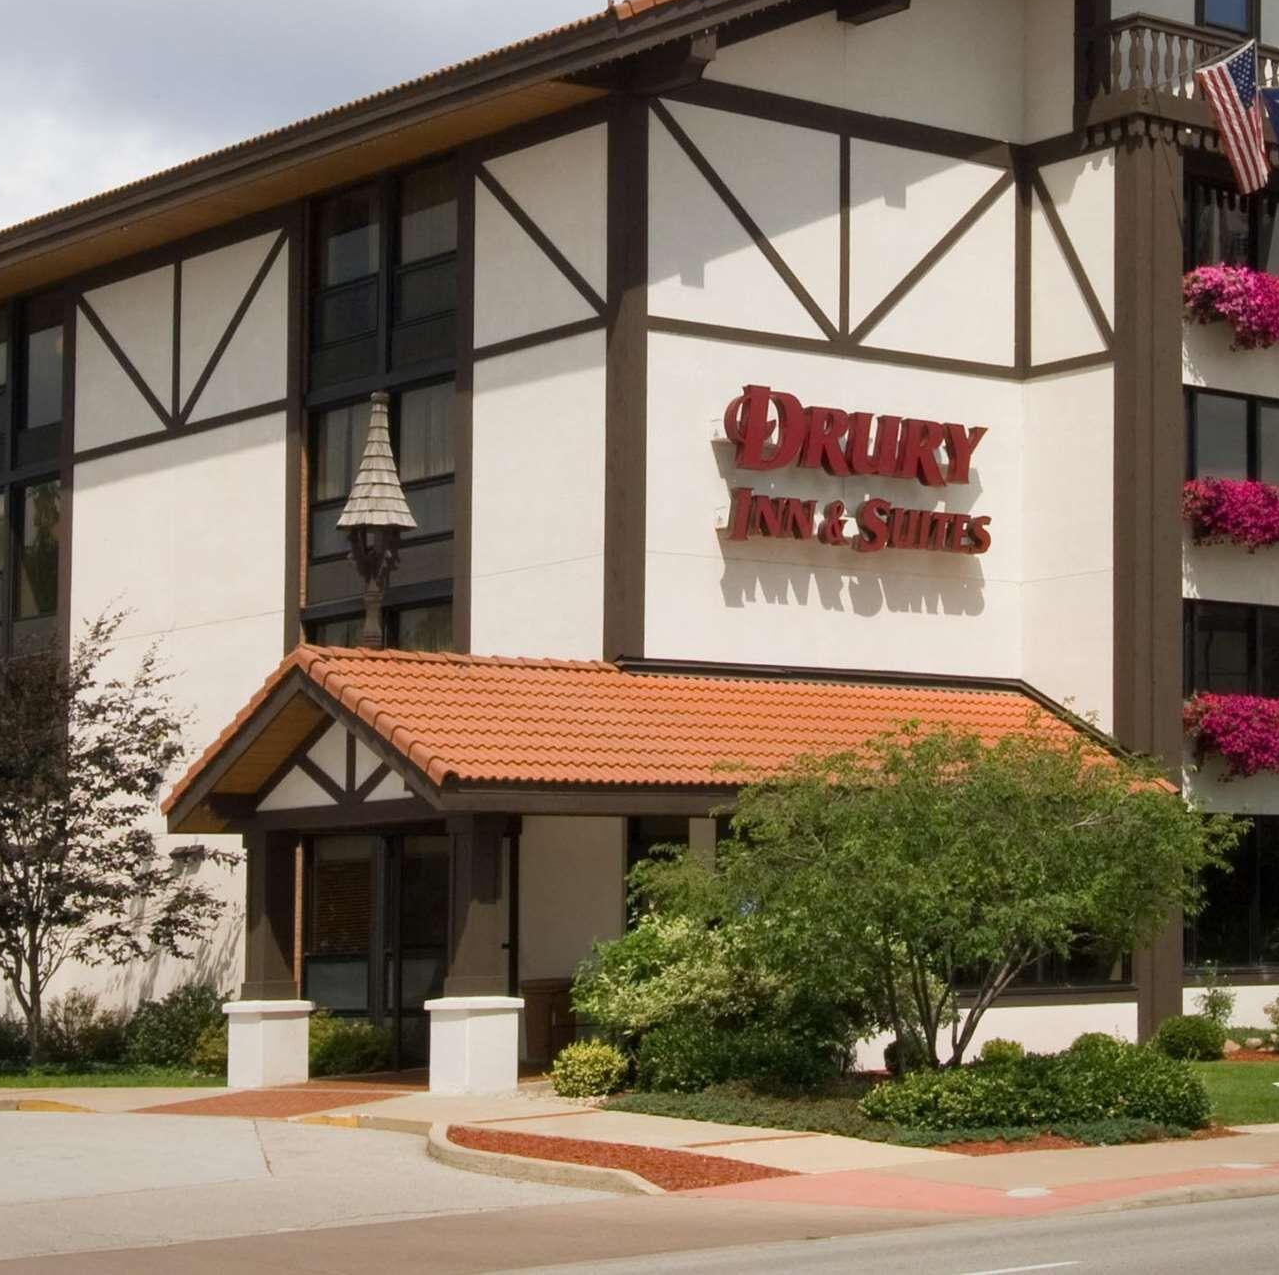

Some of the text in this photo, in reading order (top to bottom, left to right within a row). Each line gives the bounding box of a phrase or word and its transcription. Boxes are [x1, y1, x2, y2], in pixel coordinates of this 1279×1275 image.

[723, 384, 989, 487] DRURY
[729, 487, 992, 555] INN & SUITES
